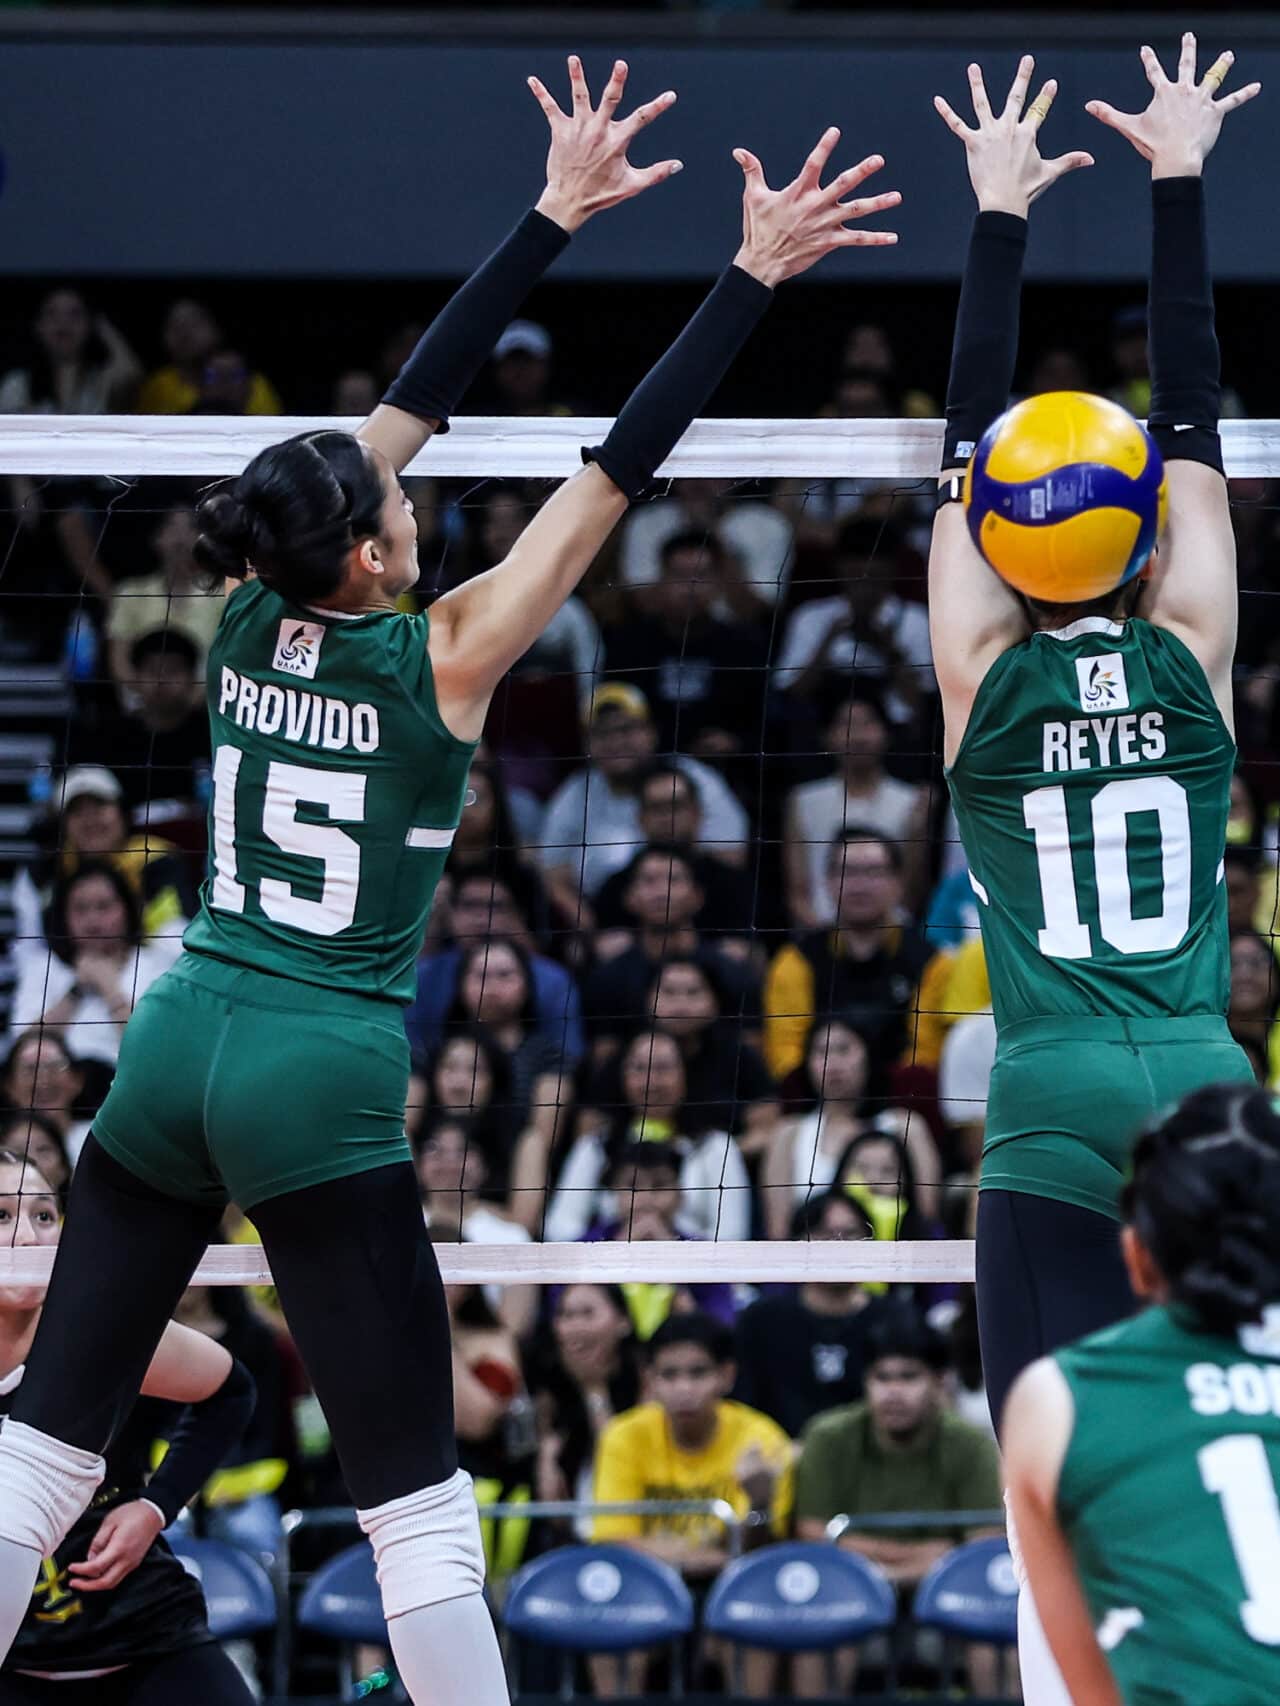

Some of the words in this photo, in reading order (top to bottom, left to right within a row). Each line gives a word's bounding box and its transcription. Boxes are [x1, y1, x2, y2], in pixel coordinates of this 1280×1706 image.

[218, 665, 380, 753] PROVIDO
[276, 660, 301, 671] UAAP
[1043, 711, 1167, 773] REYES
[210, 744, 367, 936] 15
[1022, 775, 1192, 960] 10
